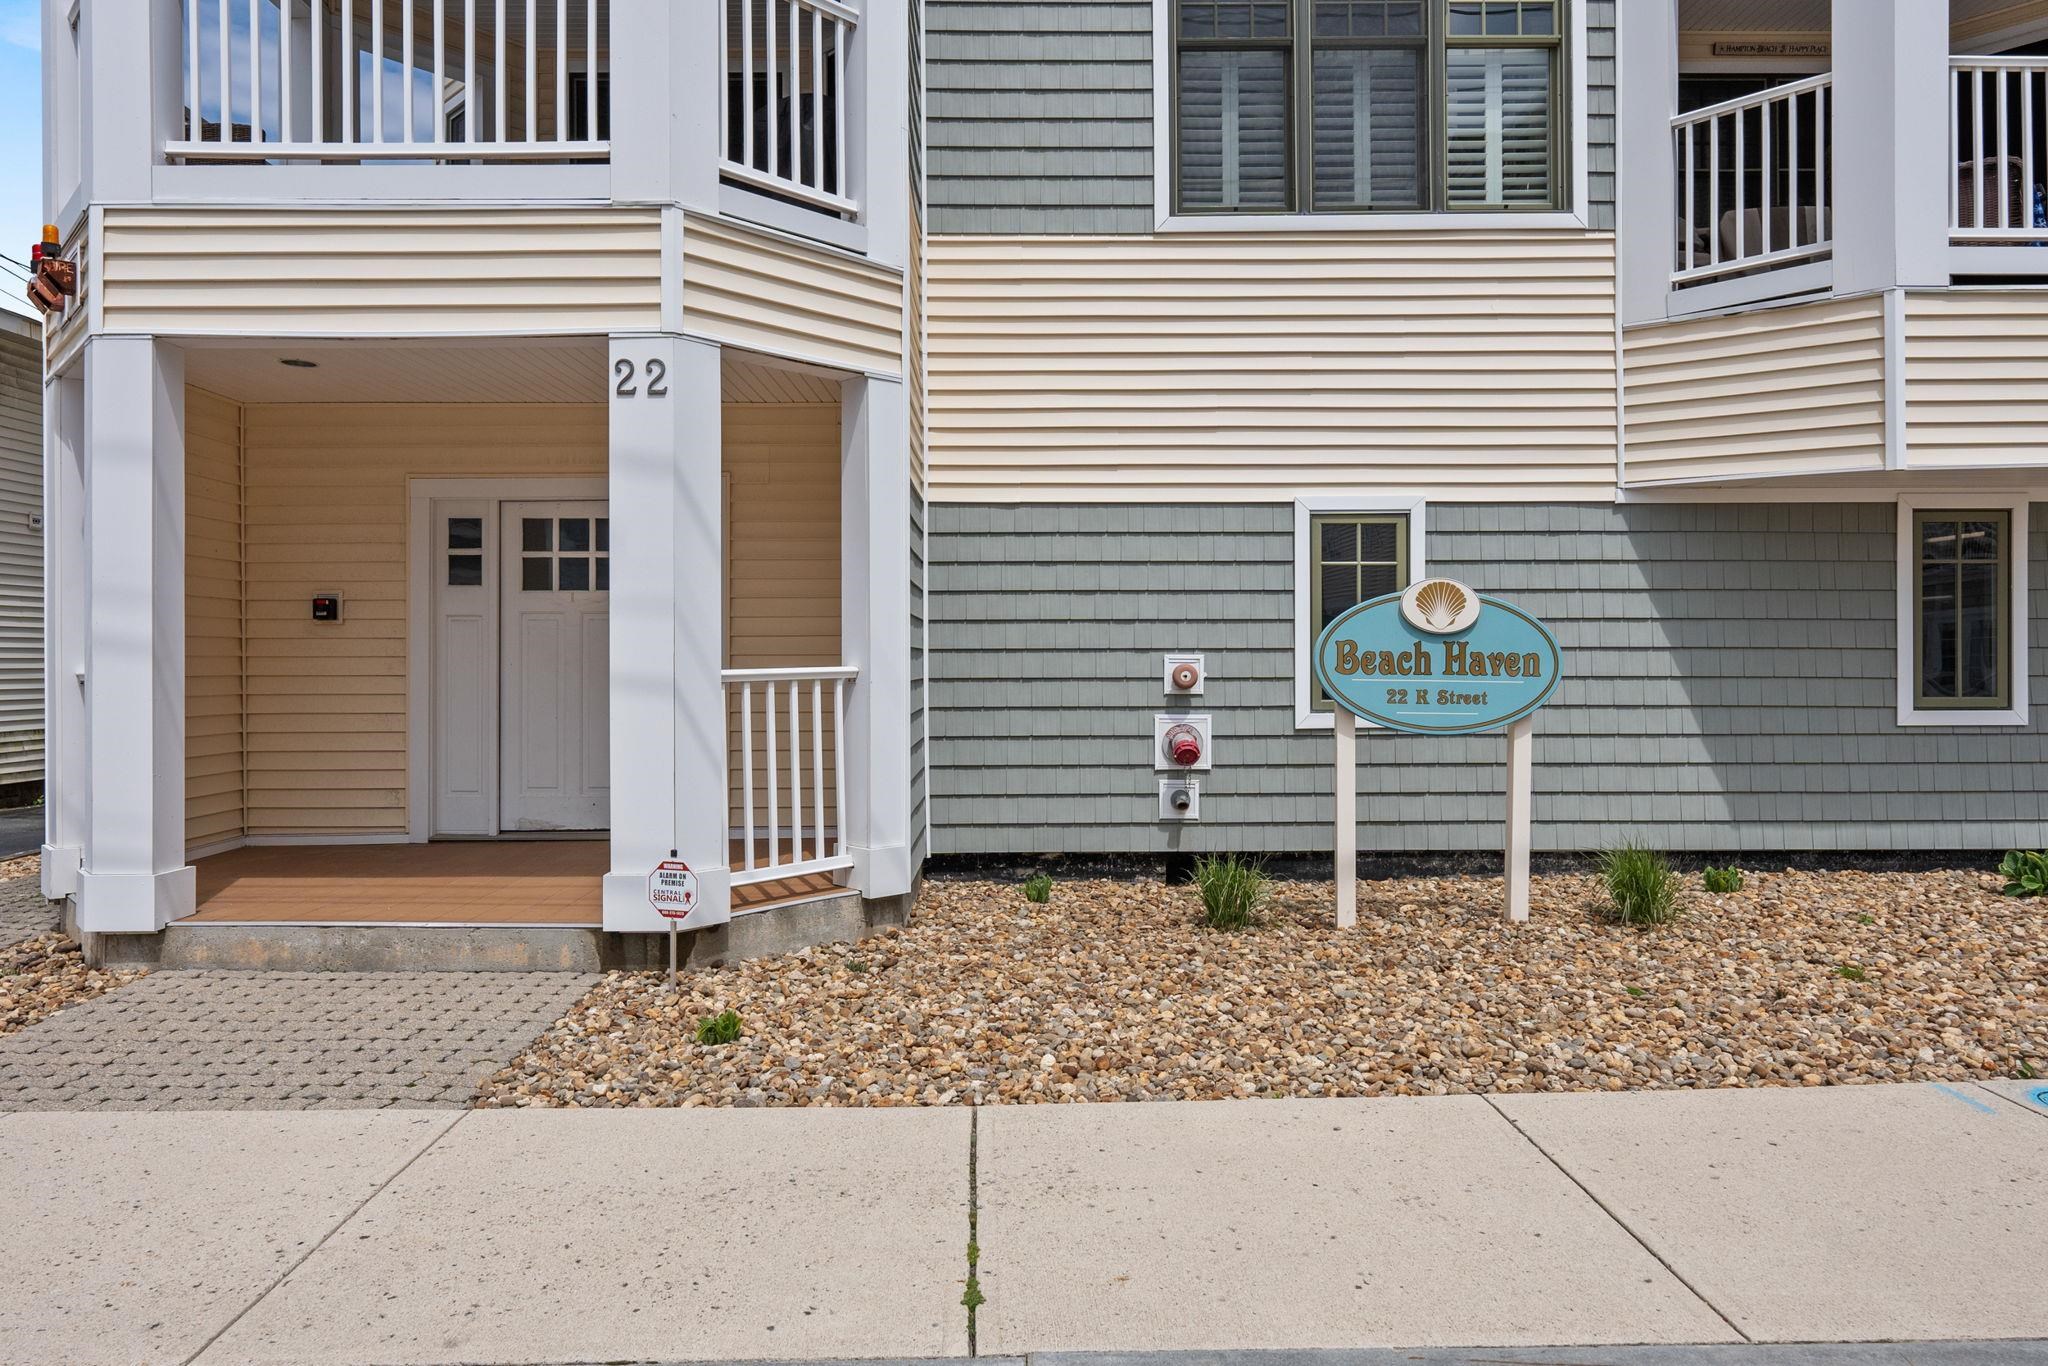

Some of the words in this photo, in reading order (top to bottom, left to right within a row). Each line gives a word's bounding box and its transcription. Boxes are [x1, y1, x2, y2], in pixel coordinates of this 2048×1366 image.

[614, 358, 668, 396] 22
[1334, 639, 1433, 676] Beach
[1442, 640, 1542, 678] Haven
[1386, 688, 1409, 705] 22
[1415, 688, 1428, 705] K
[1436, 688, 1489, 706] Street
[660, 879, 685, 887] PREMISE
